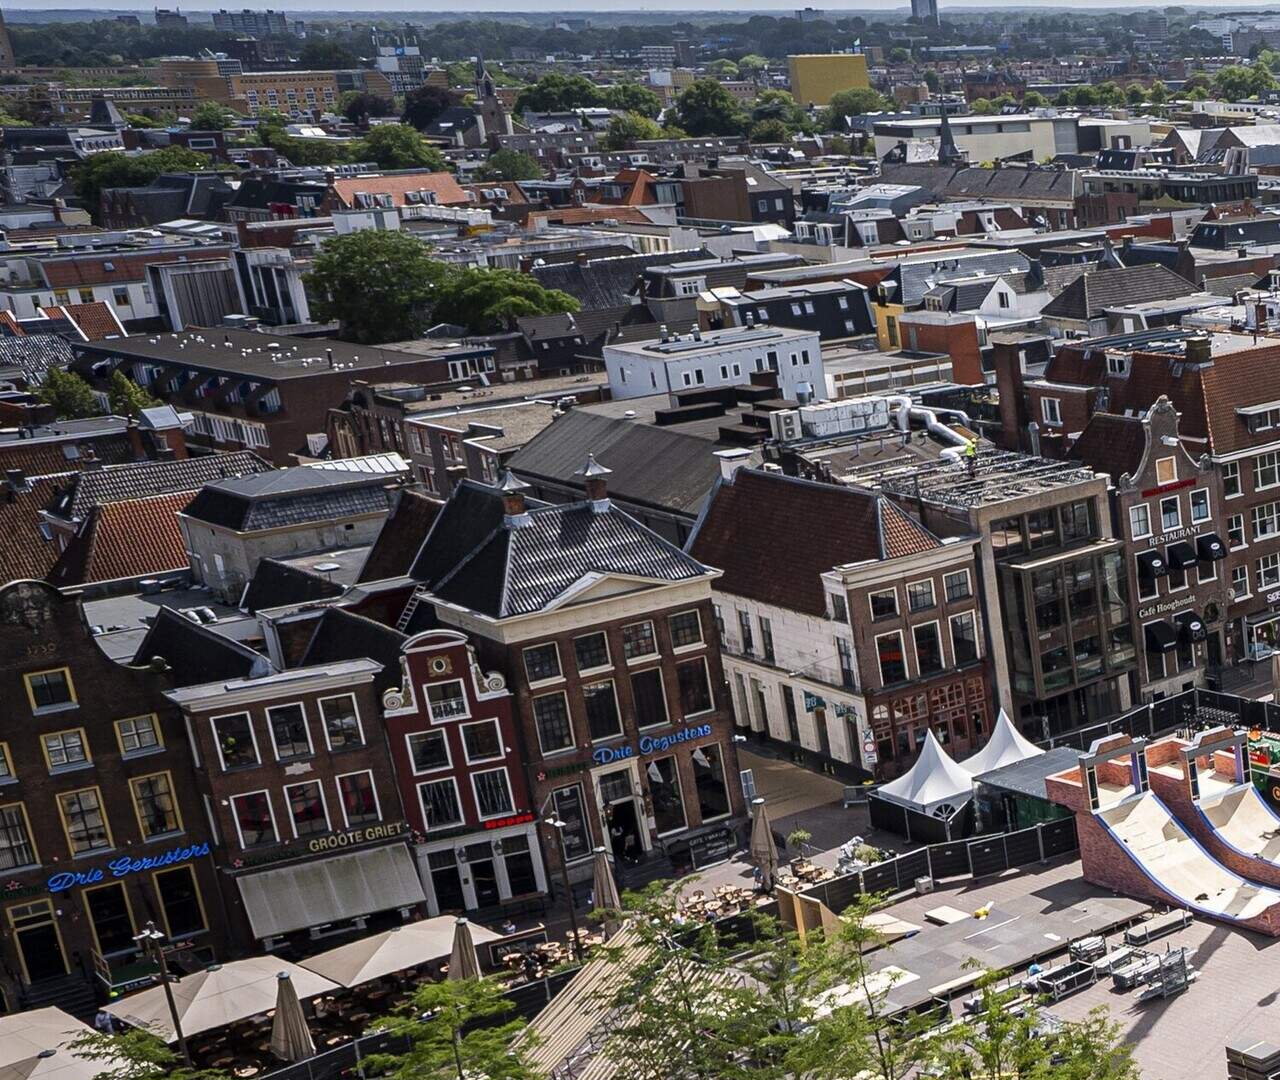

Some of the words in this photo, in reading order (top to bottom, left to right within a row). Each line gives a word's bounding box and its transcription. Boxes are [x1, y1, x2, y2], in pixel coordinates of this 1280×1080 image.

[1149, 525, 1201, 546] RESTAURANT
[593, 744, 633, 764] Drie
[640, 723, 712, 754] Gezusters
[309, 831, 363, 852] GROOTE
[365, 821, 402, 841] GRIET
[47, 869, 104, 893] Drie
[108, 842, 210, 877] Gezusters
